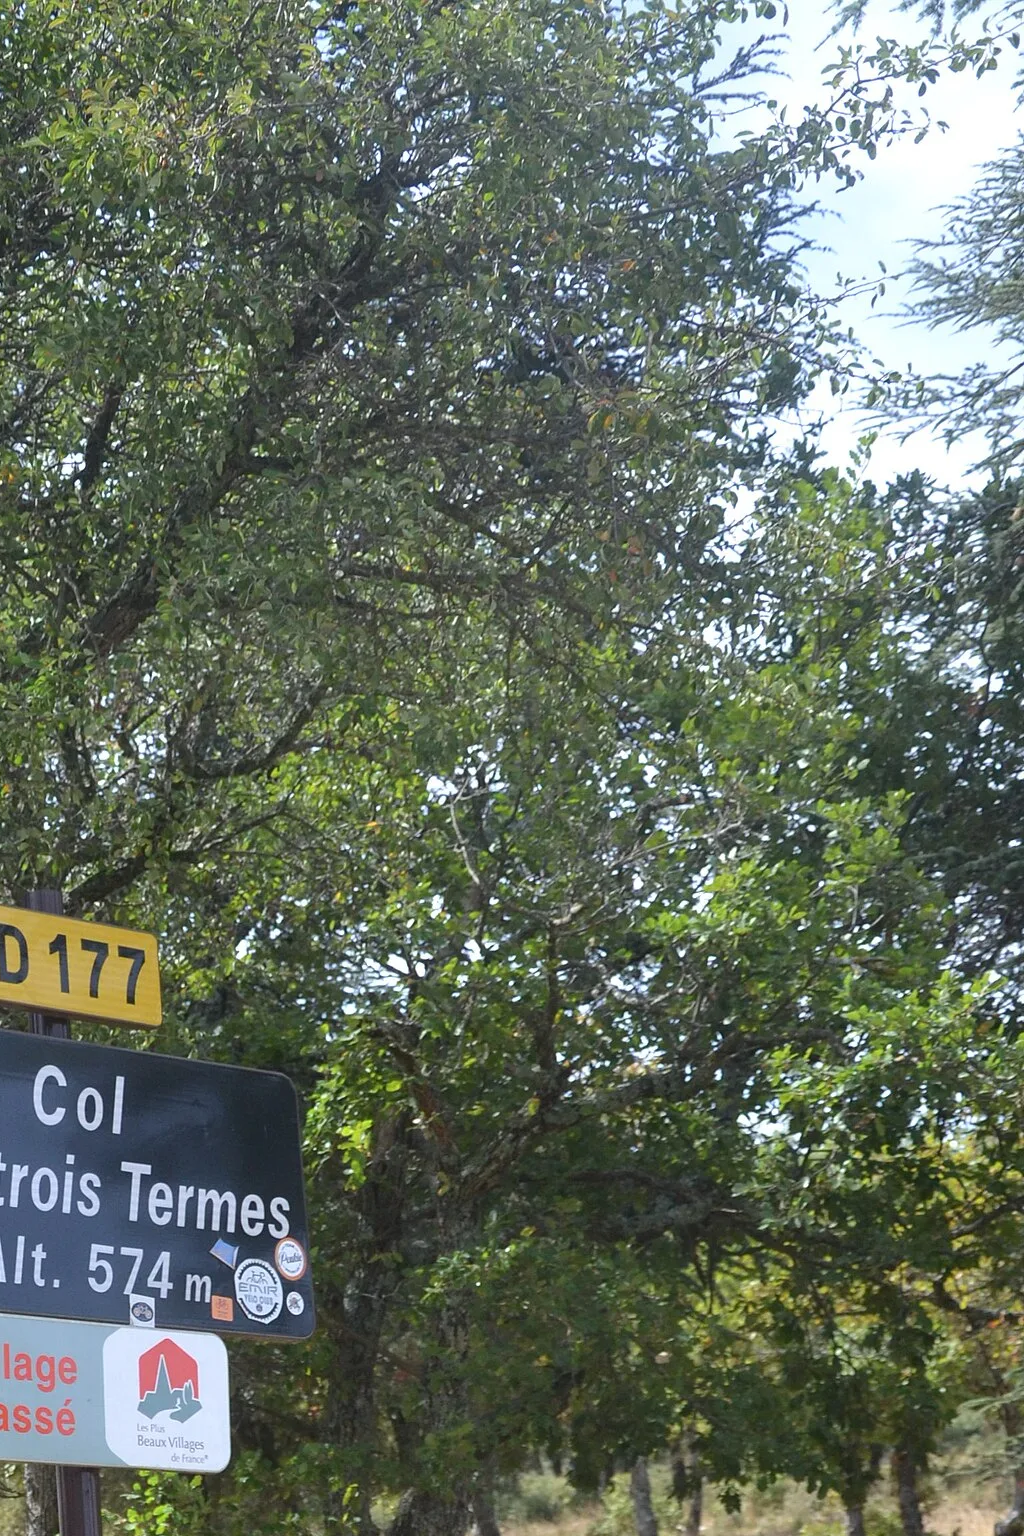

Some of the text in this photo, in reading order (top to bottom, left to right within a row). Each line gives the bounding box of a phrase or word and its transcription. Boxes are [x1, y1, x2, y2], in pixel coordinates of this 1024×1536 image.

[49, 933, 145, 1005] 177
[32, 1064, 125, 1135] Col
[121, 1161, 291, 1239] Termes
[88, 1244, 174, 1299] 574
[184, 1275, 212, 1303] m
[238, 1282, 278, 1297] EMIR
[137, 1423, 165, 1433] Les Plus
[137, 1435, 205, 1453] Beaux Villages
[171, 1453, 180, 1463] de
